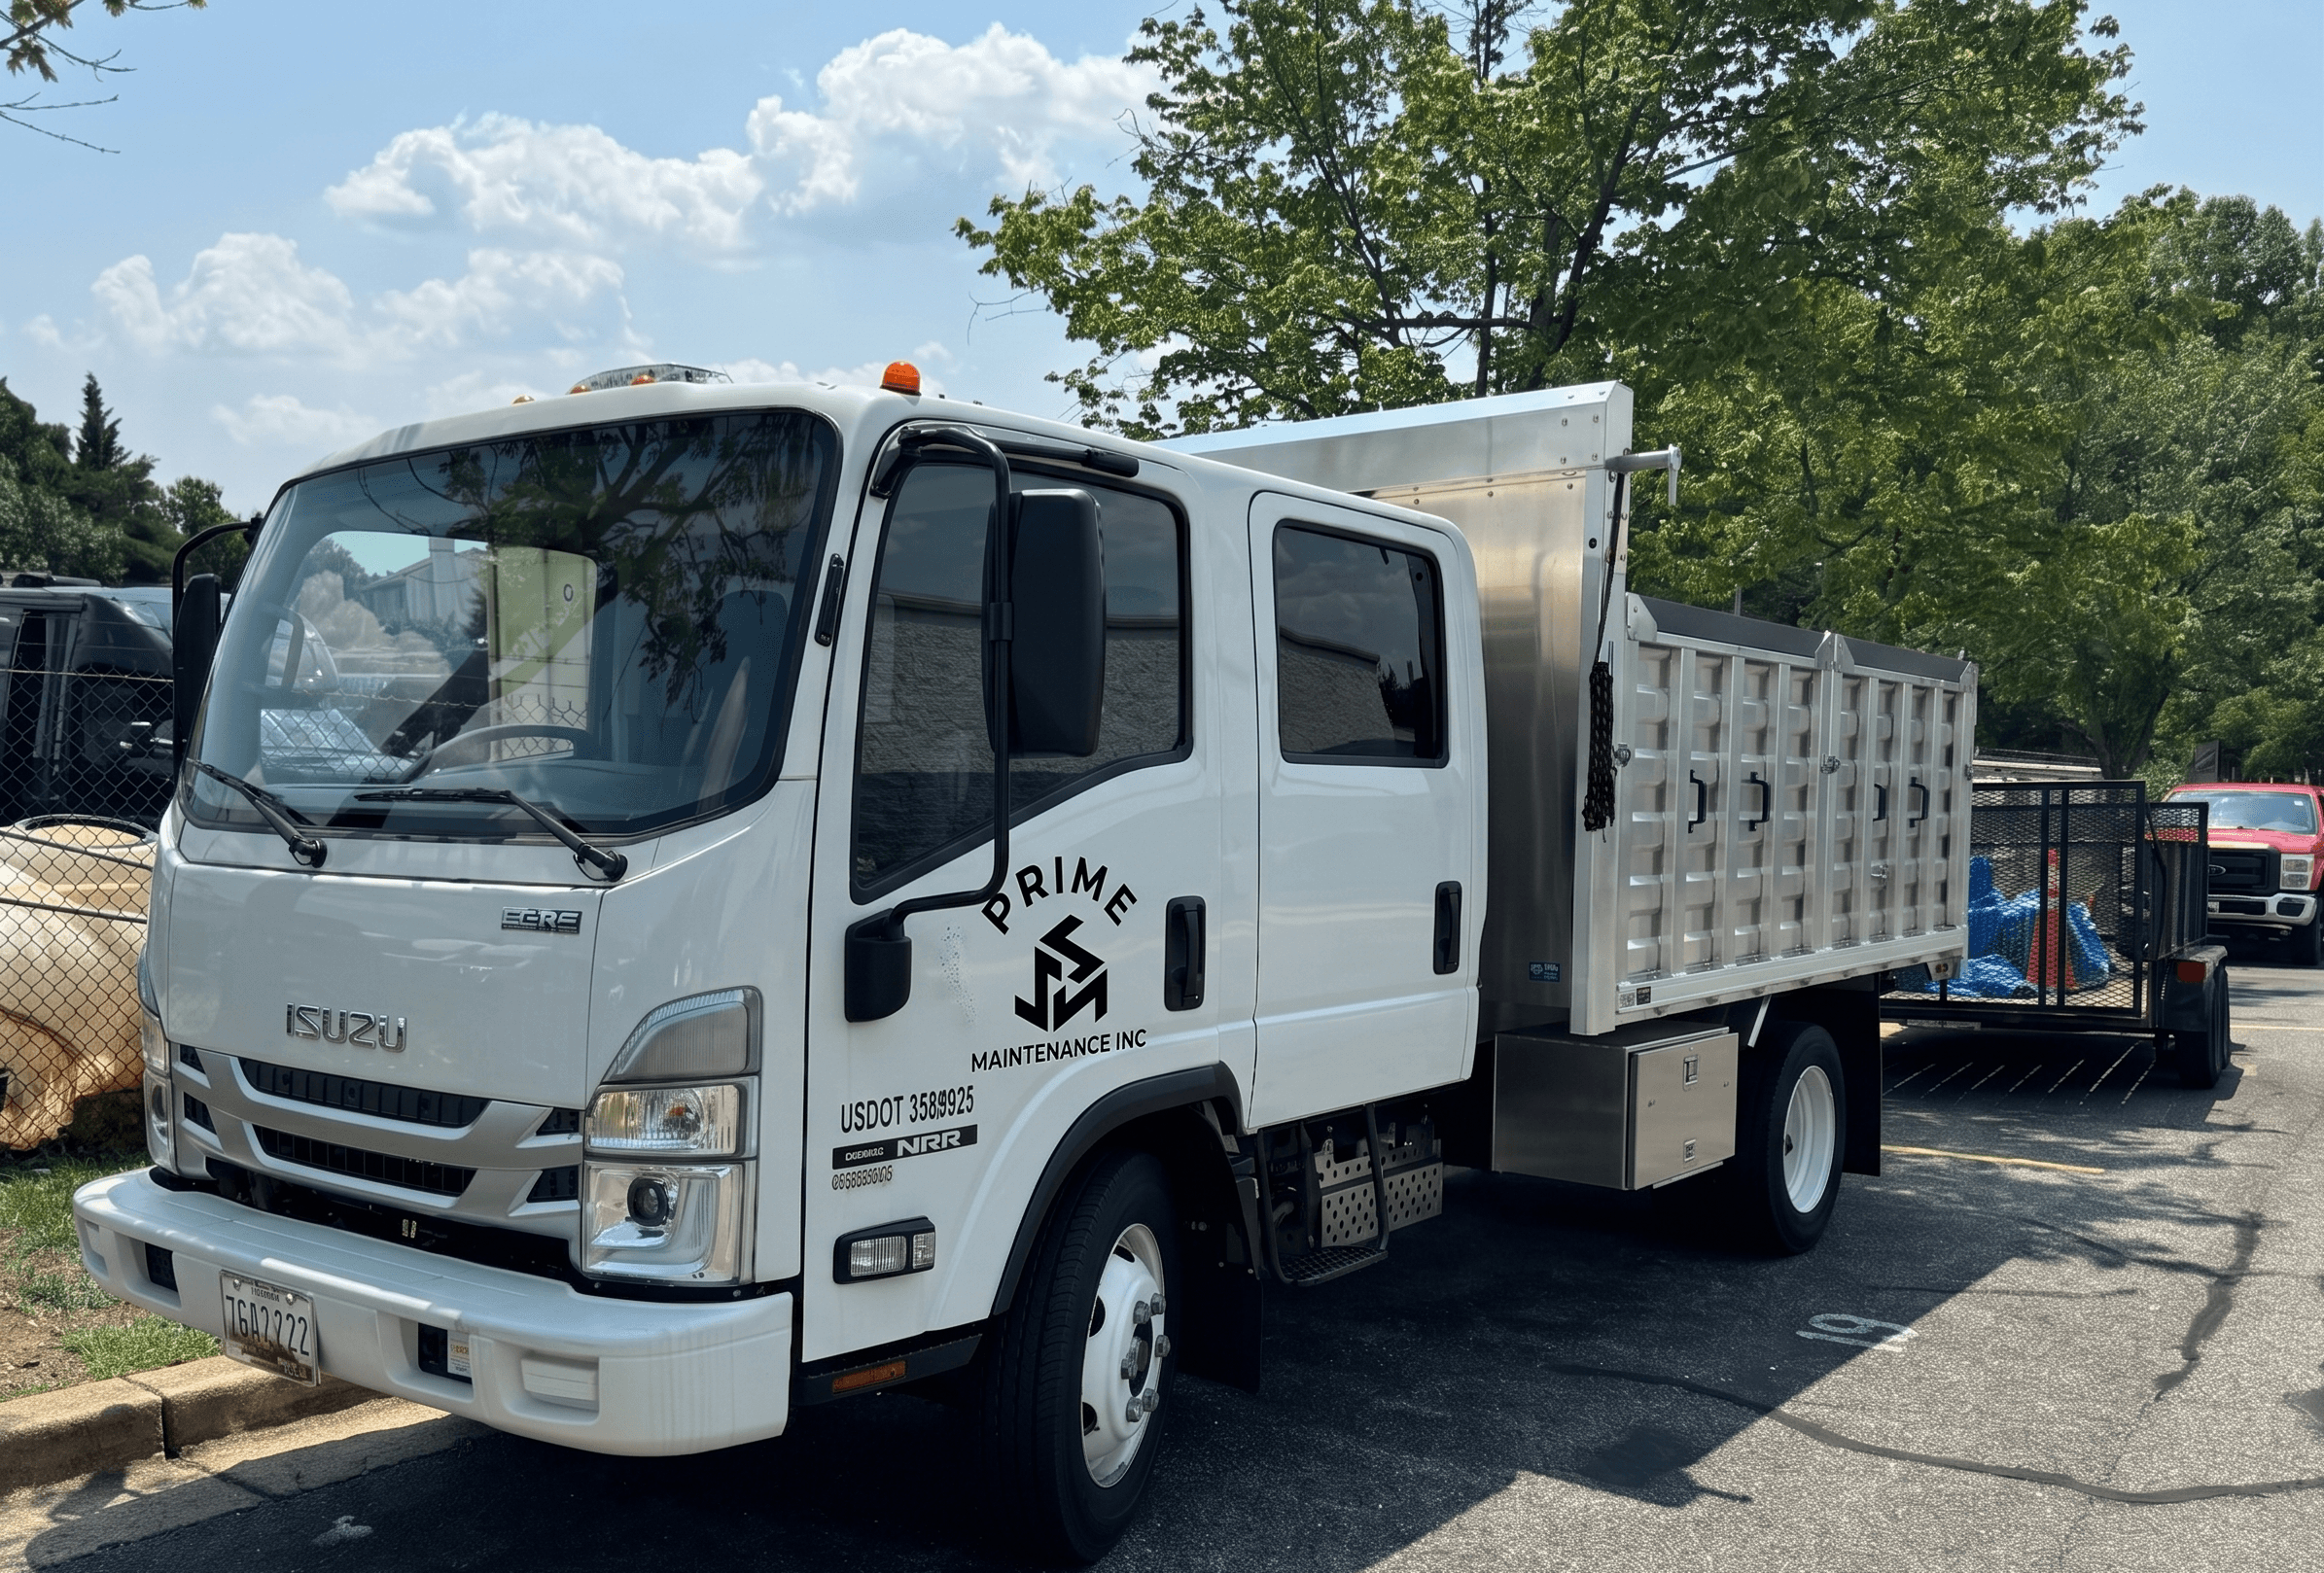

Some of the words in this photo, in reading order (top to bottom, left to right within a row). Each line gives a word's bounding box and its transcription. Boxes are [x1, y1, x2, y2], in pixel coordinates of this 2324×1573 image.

[981, 856, 1138, 935] PRIME
[286, 1002, 407, 1053] ISUZU
[971, 1033, 1111, 1072] MAINTENANCE
[1115, 1029, 1147, 1051] INC
[841, 1095, 904, 1134] USDOT
[897, 1130, 962, 1157] NRR
